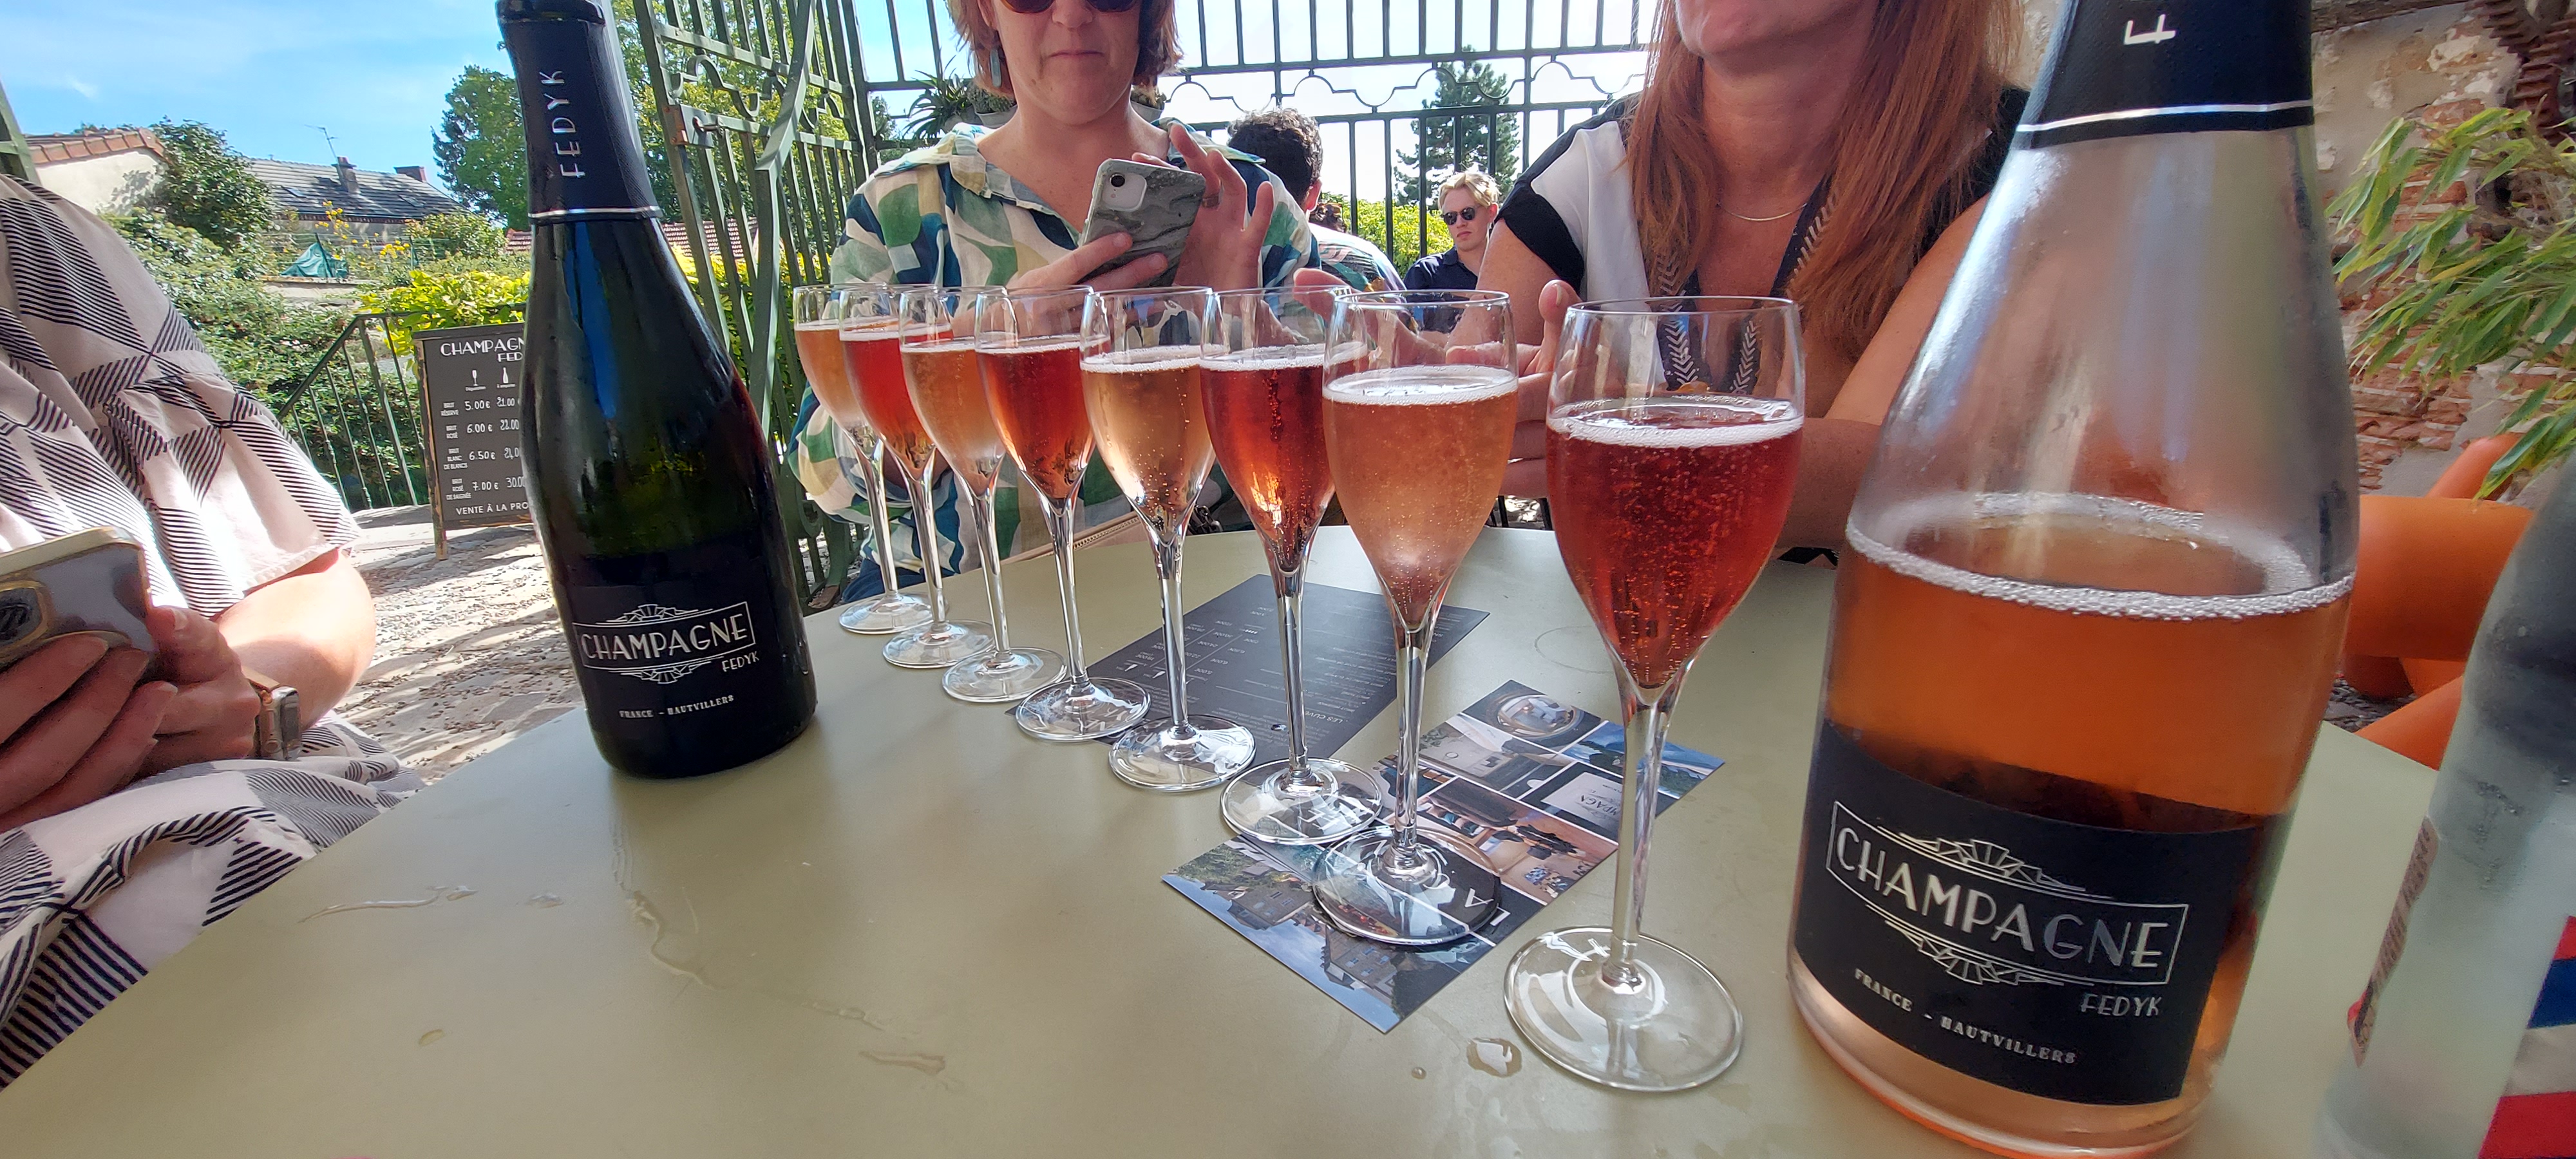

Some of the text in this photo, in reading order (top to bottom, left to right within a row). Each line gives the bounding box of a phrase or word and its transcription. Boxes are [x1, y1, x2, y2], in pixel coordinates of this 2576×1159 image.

[540, 71, 586, 178] FEDYK
[497, 352, 524, 362] FED
[456, 505, 484, 515] VENTE
[487, 504, 493, 512] À
[510, 502, 529, 511] PRO
[582, 614, 748, 660] CHAMPAGNE
[722, 651, 759, 672] FEDYK
[619, 710, 654, 719] FRANCE
[667, 695, 734, 716] HAUTVILLERS
[1837, 827, 2169, 968] CHAMPAGNE
[1855, 968, 1913, 1013] FRANCE
[1940, 1017, 2077, 1065] HAUTVILLERS
[2080, 992, 2164, 1019] FEDYK
